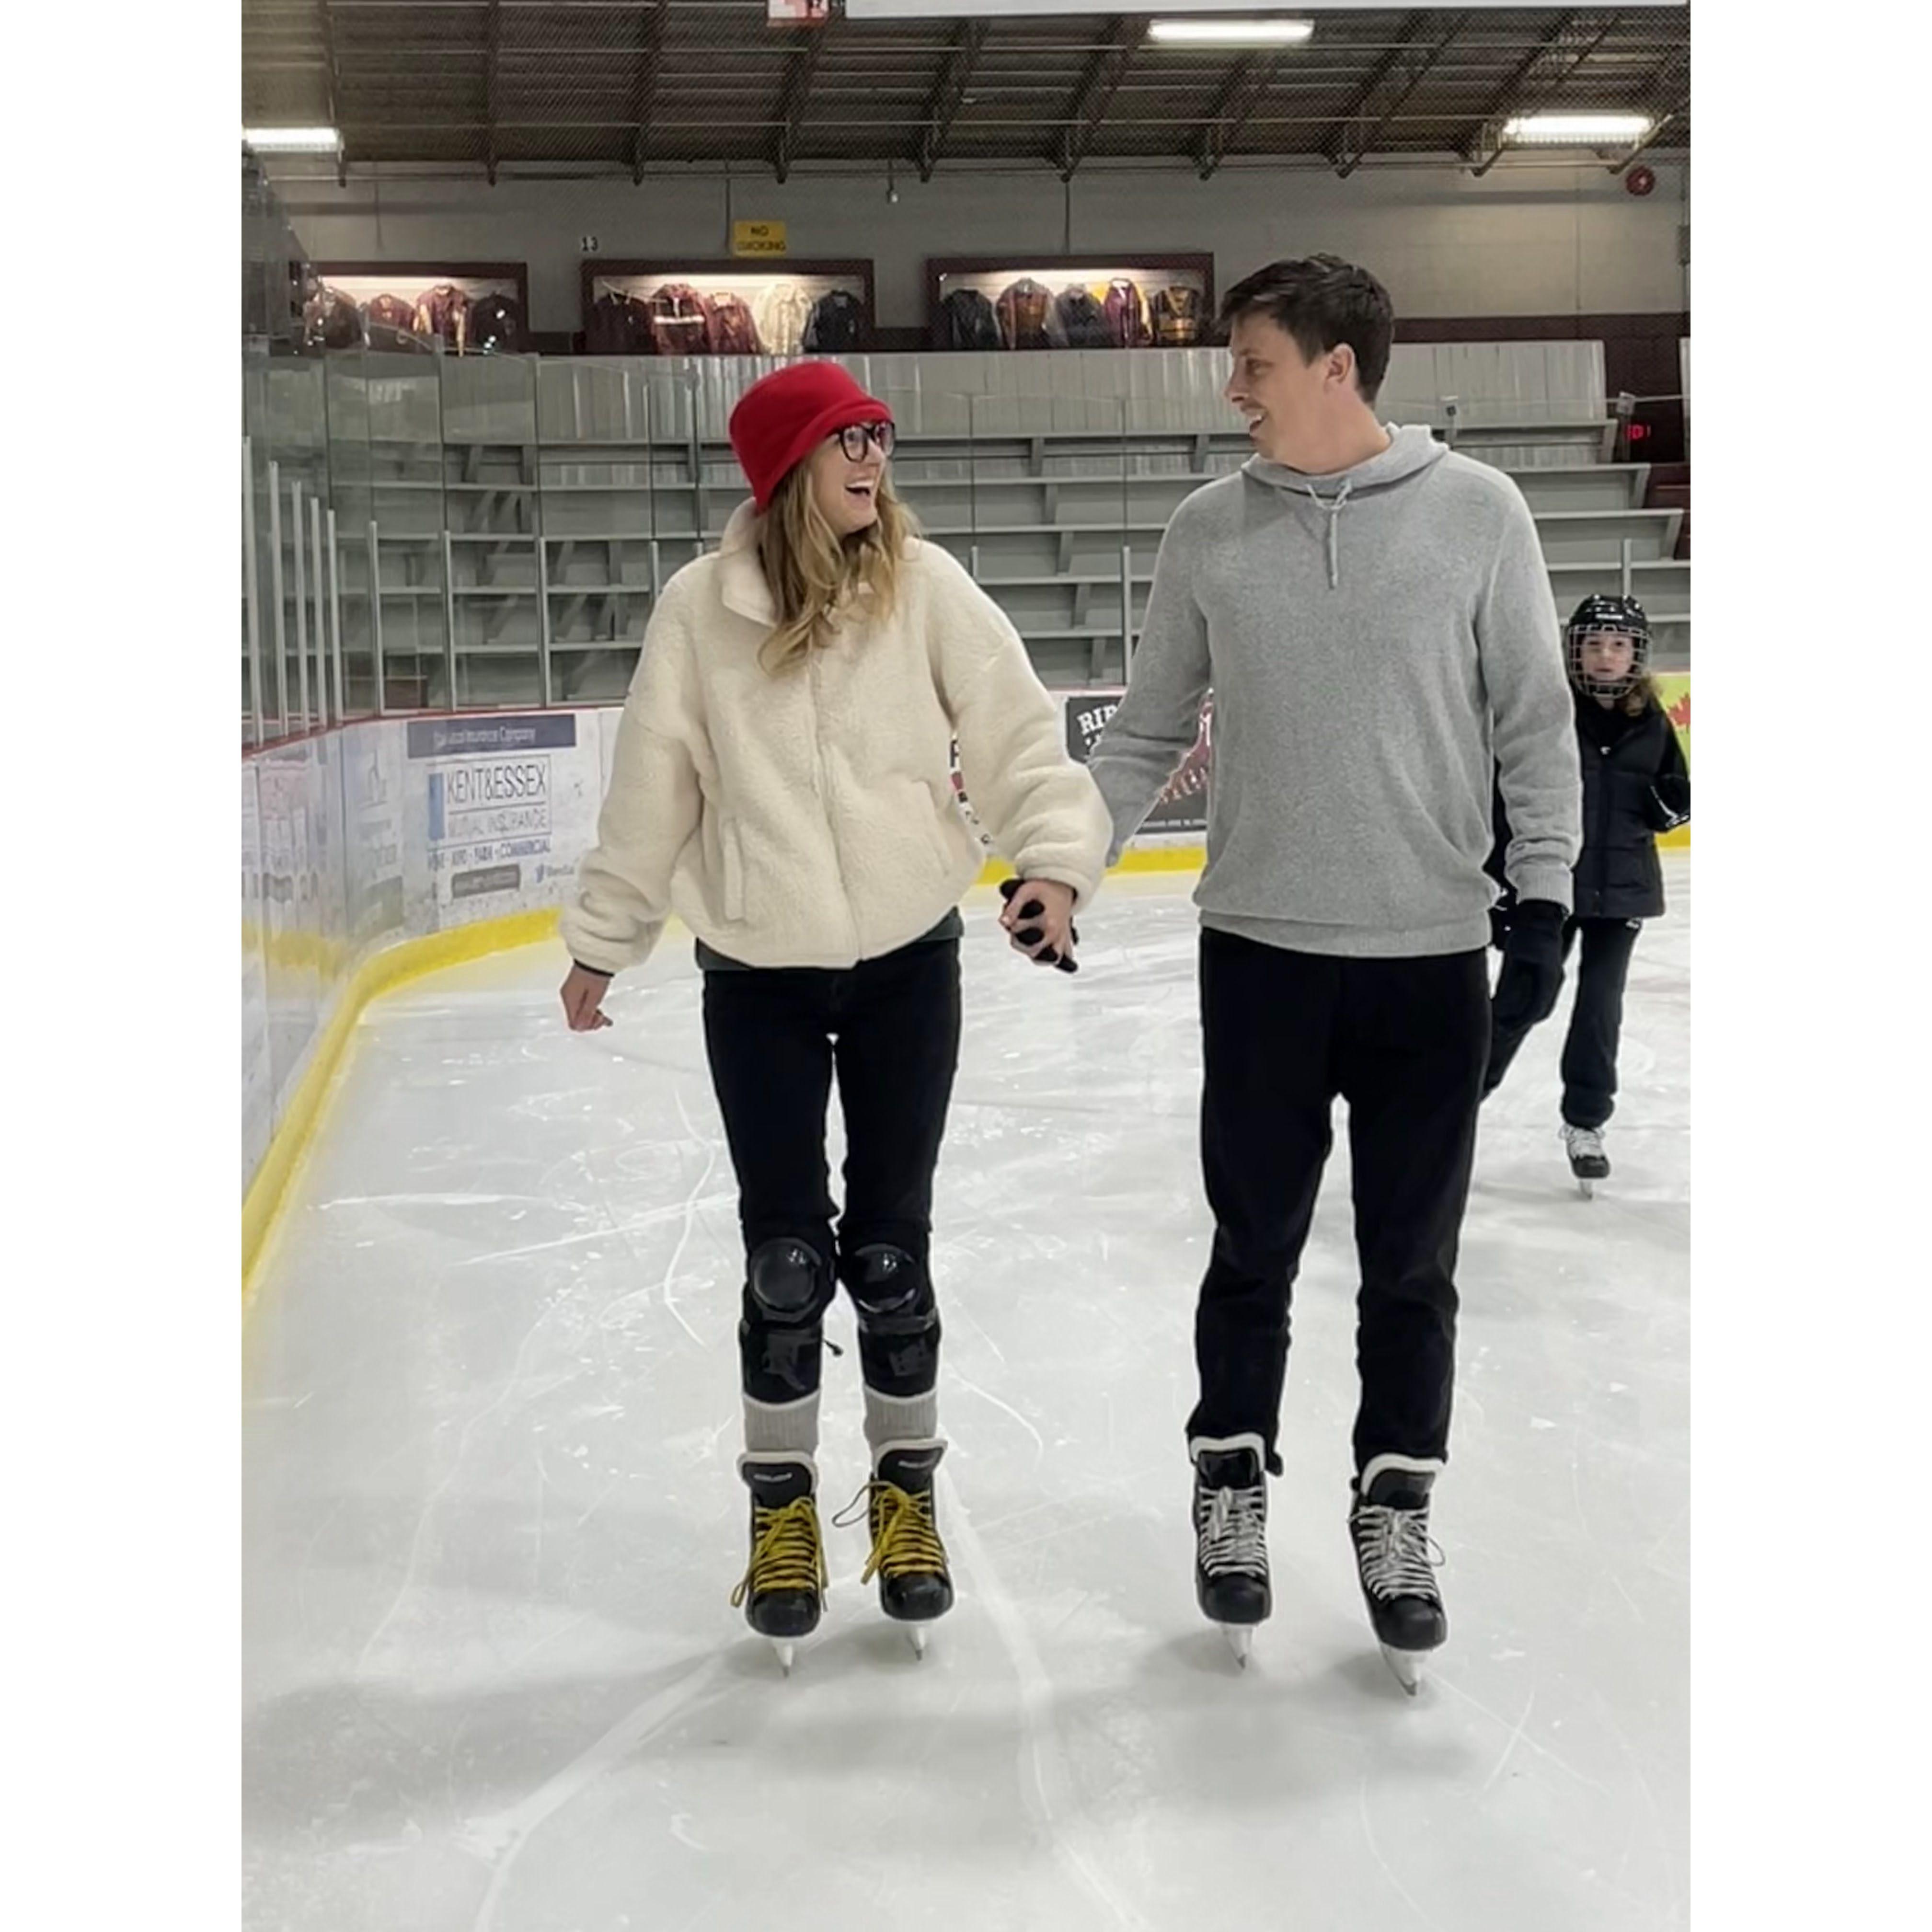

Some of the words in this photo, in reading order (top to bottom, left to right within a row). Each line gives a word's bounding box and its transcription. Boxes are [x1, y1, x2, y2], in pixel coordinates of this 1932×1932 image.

[750, 225, 769, 236] NO
[581, 236, 598, 252] 13
[447, 765, 546, 804] KENT&ESSEX
